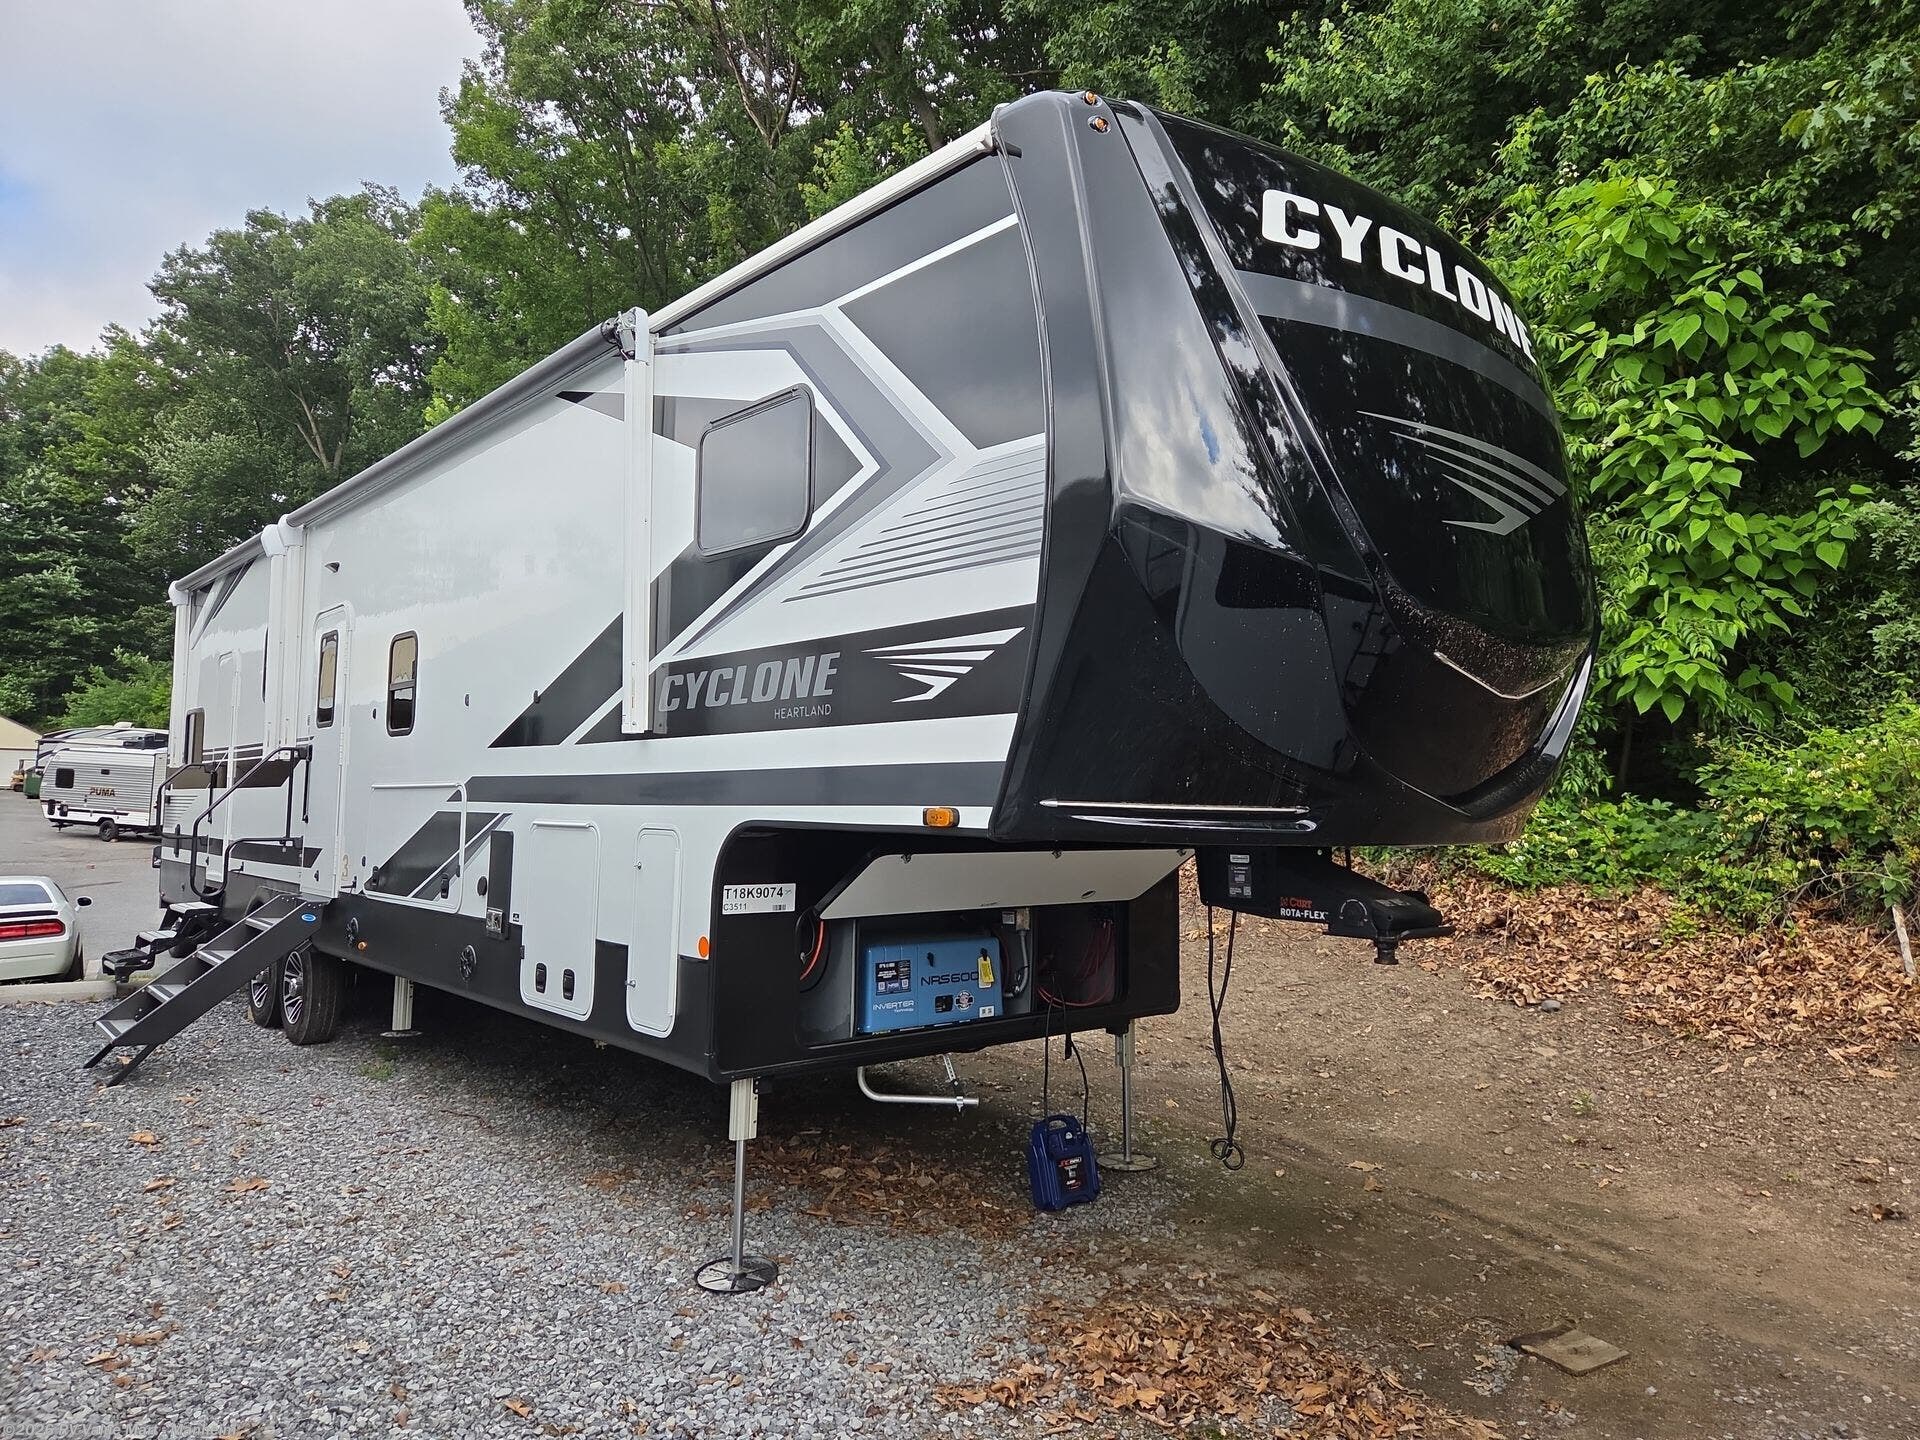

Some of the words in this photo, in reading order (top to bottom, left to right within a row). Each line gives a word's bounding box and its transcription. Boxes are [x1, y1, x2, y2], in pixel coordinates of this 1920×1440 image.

[1262, 189, 1538, 366] CYCLONE
[658, 651, 841, 712] CYCLONE
[773, 704, 832, 720] HEARTLAND
[90, 786, 115, 797] PUMA
[724, 887, 784, 900] T18K9074
[723, 903, 747, 912] C3511
[872, 1000, 915, 1011] INVERTER
